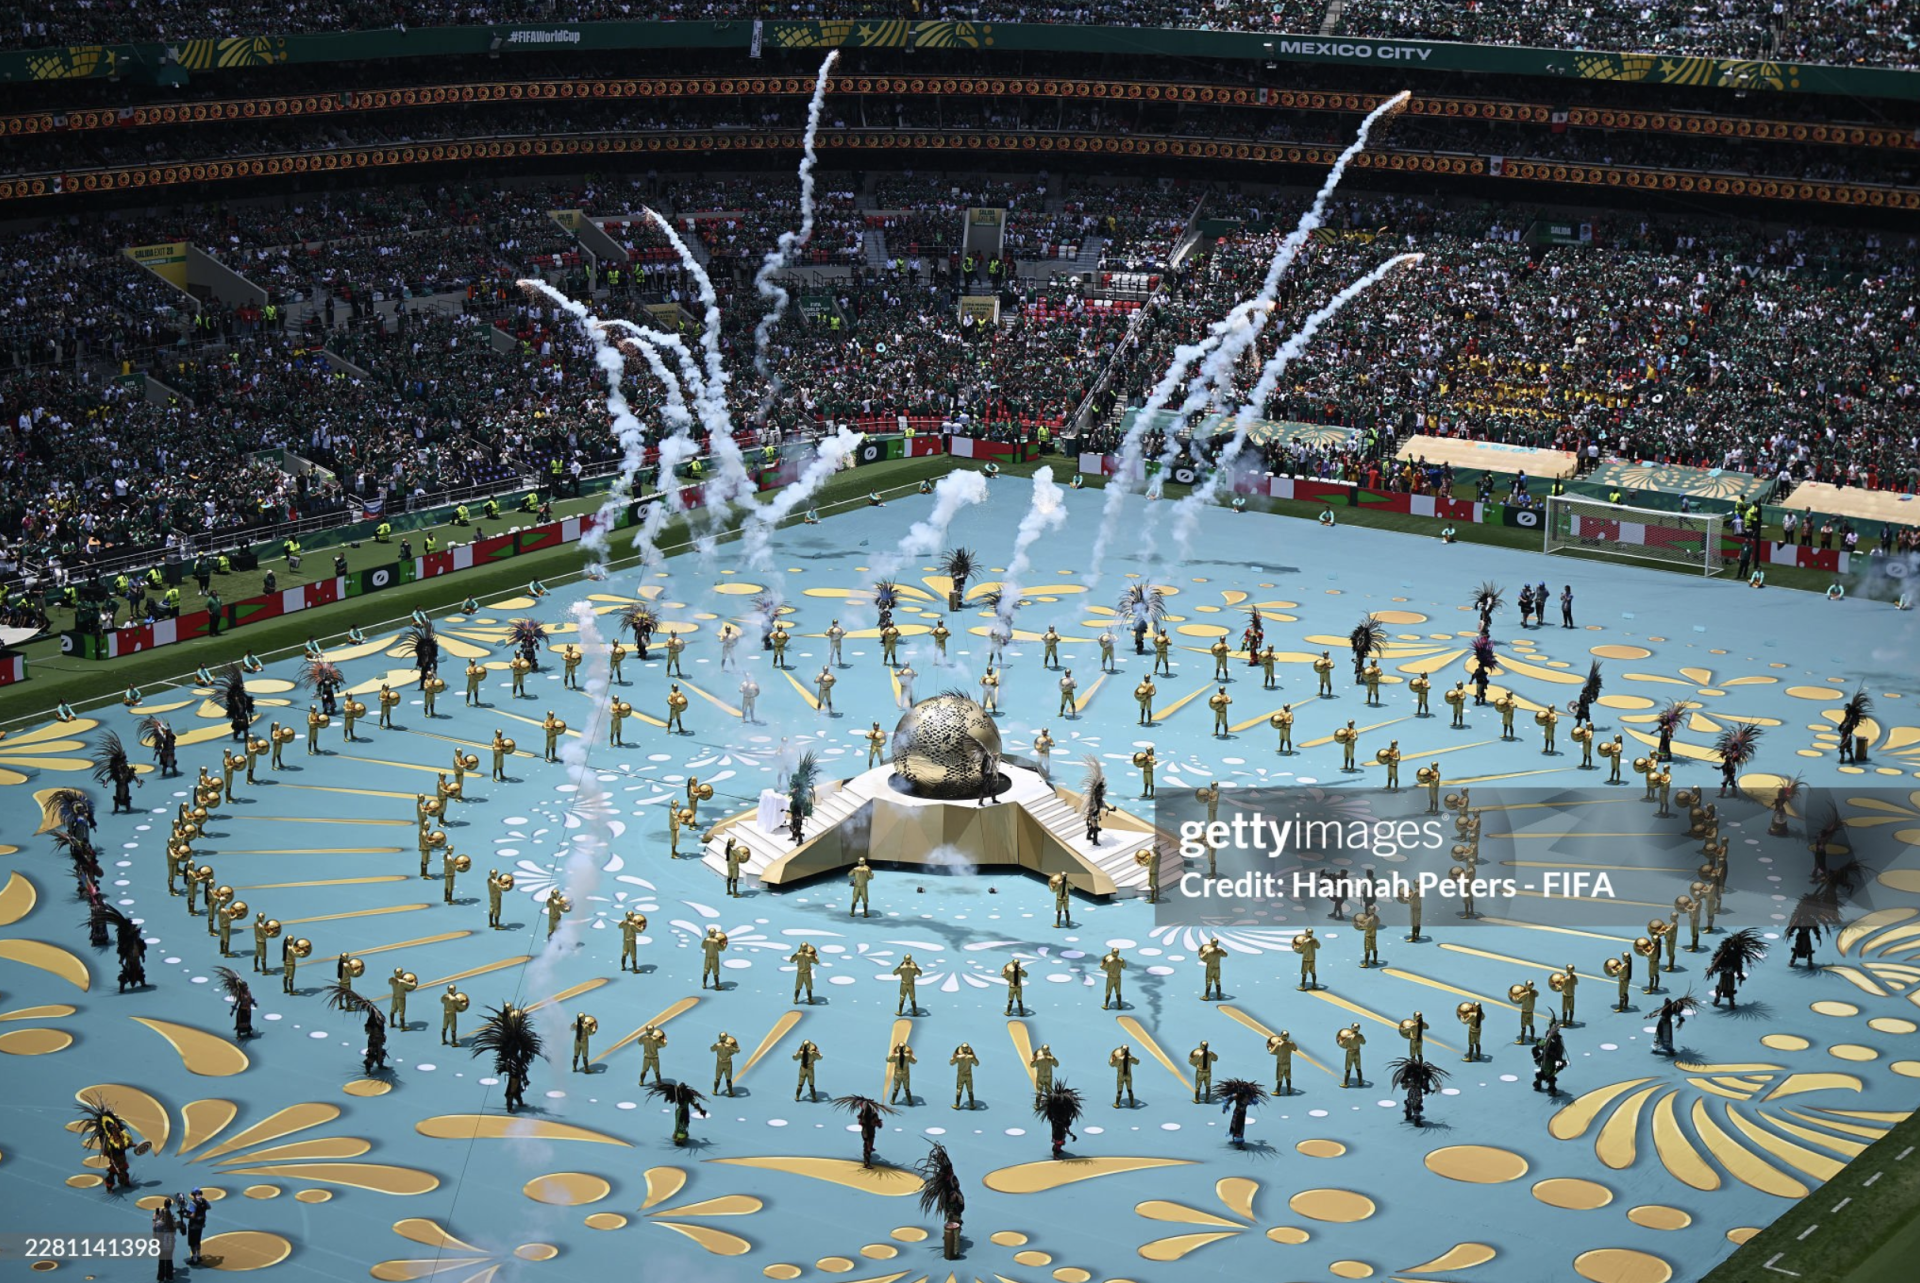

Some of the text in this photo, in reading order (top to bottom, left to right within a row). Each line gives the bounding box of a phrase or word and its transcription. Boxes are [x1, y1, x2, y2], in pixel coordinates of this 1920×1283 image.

[510, 30, 580, 44] #FIFAWorldCup
[1280, 41, 1432, 61] MEXICO CITY
[1550, 226, 1571, 235] SALIDA
[135, 249, 153, 258] SALIDA
[154, 248, 165, 256] EXIT
